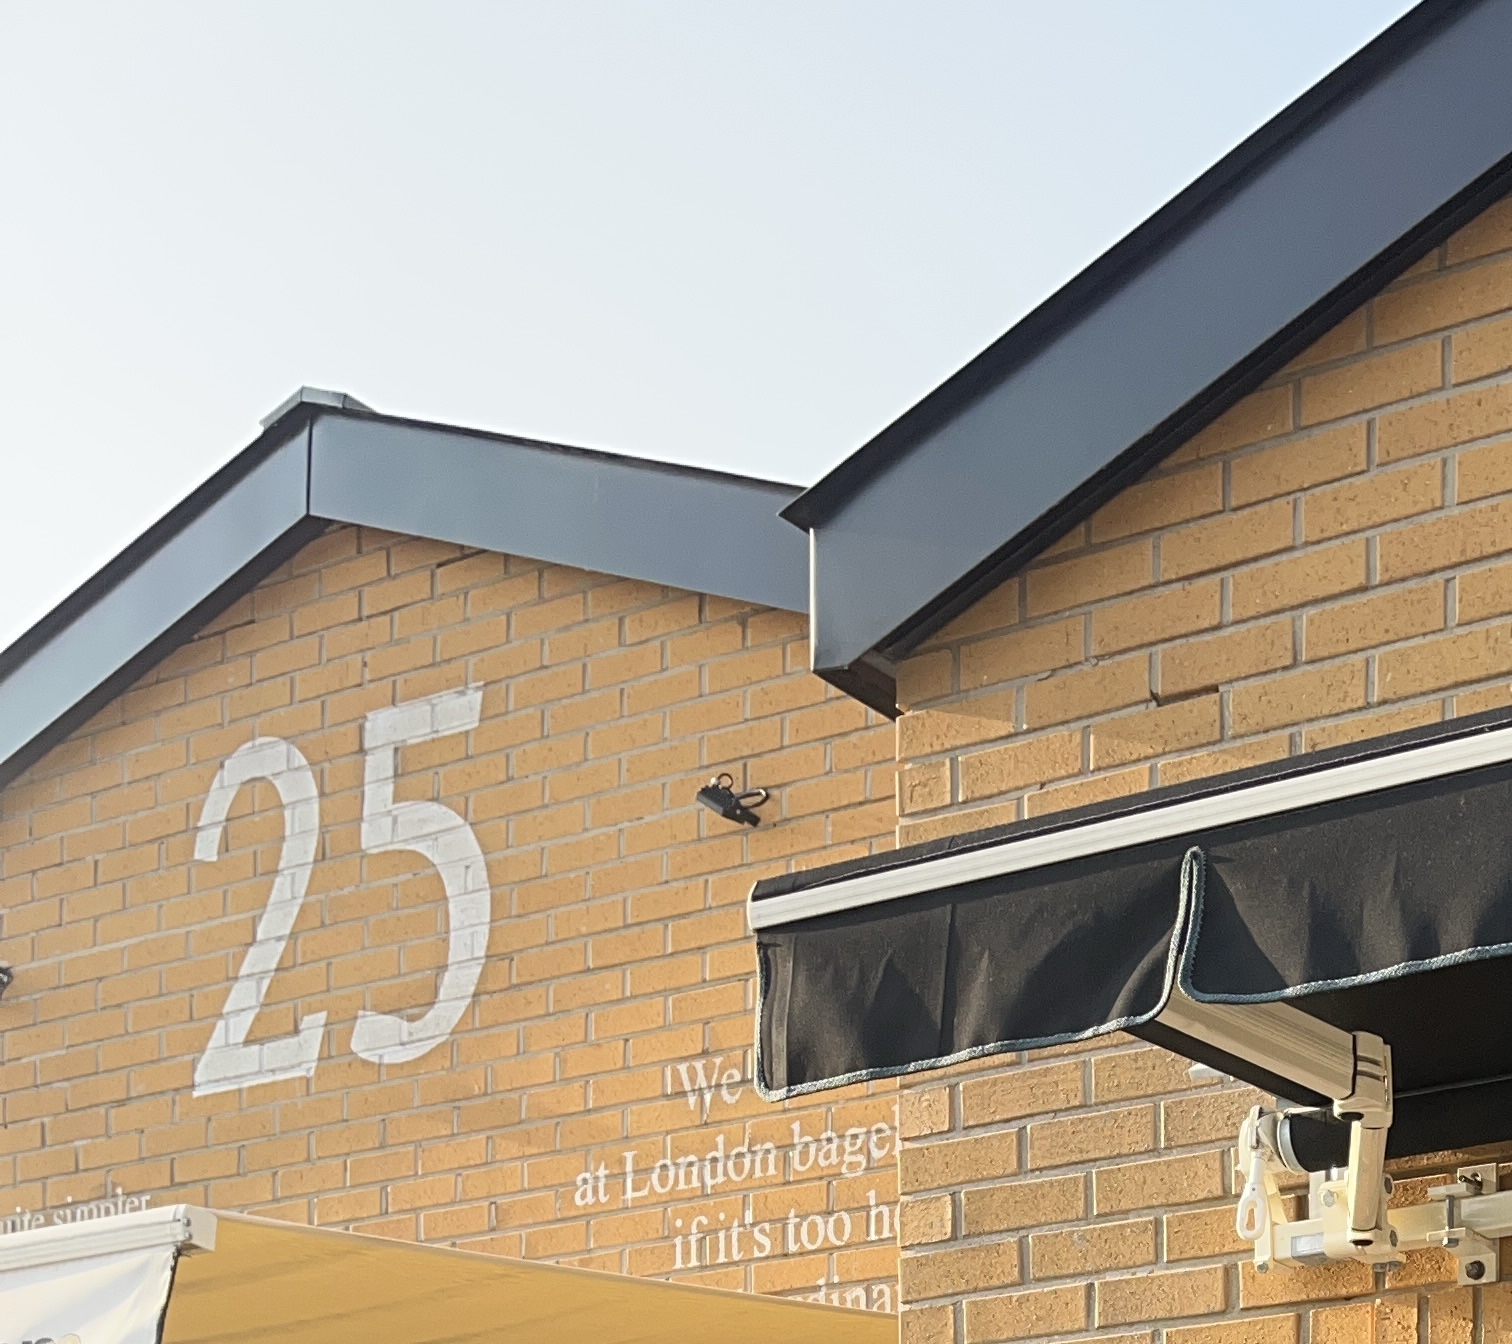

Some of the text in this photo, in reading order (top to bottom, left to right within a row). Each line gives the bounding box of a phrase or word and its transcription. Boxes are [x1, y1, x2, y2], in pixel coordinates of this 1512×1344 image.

[193, 682, 491, 1098] 25
[574, 1160, 610, 1206] at
[622, 1134, 777, 1199] London
[673, 1189, 900, 1269] if it's too h
